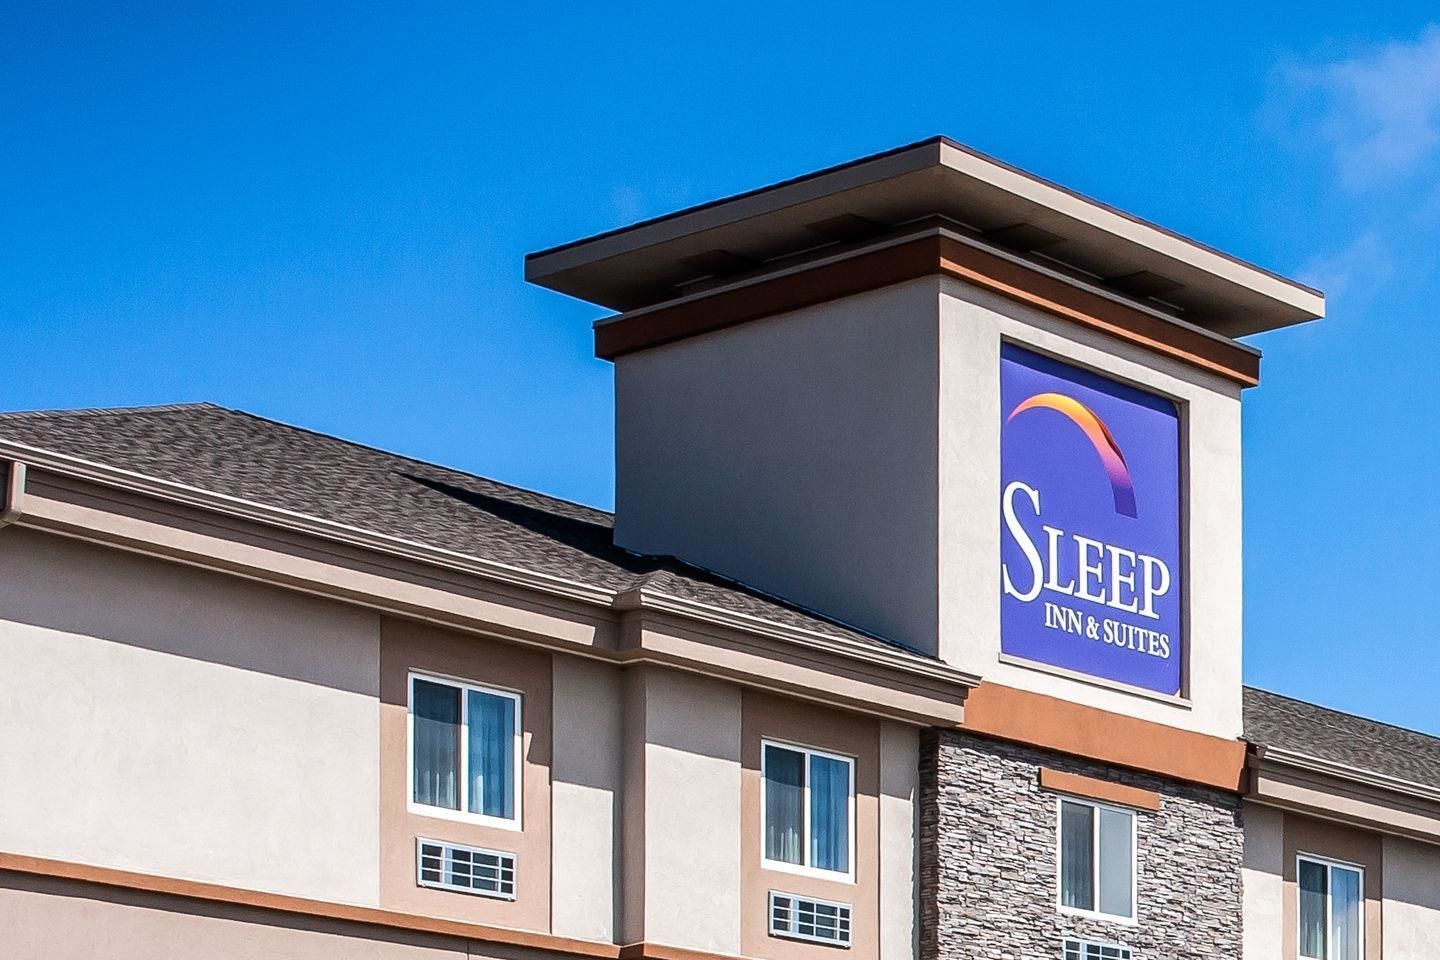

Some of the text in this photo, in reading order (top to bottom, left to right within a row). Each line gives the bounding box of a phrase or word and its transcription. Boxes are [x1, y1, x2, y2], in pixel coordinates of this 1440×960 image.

[1002, 481, 1171, 619] SLEEP
[1044, 601, 1170, 659] INN & SUITES
